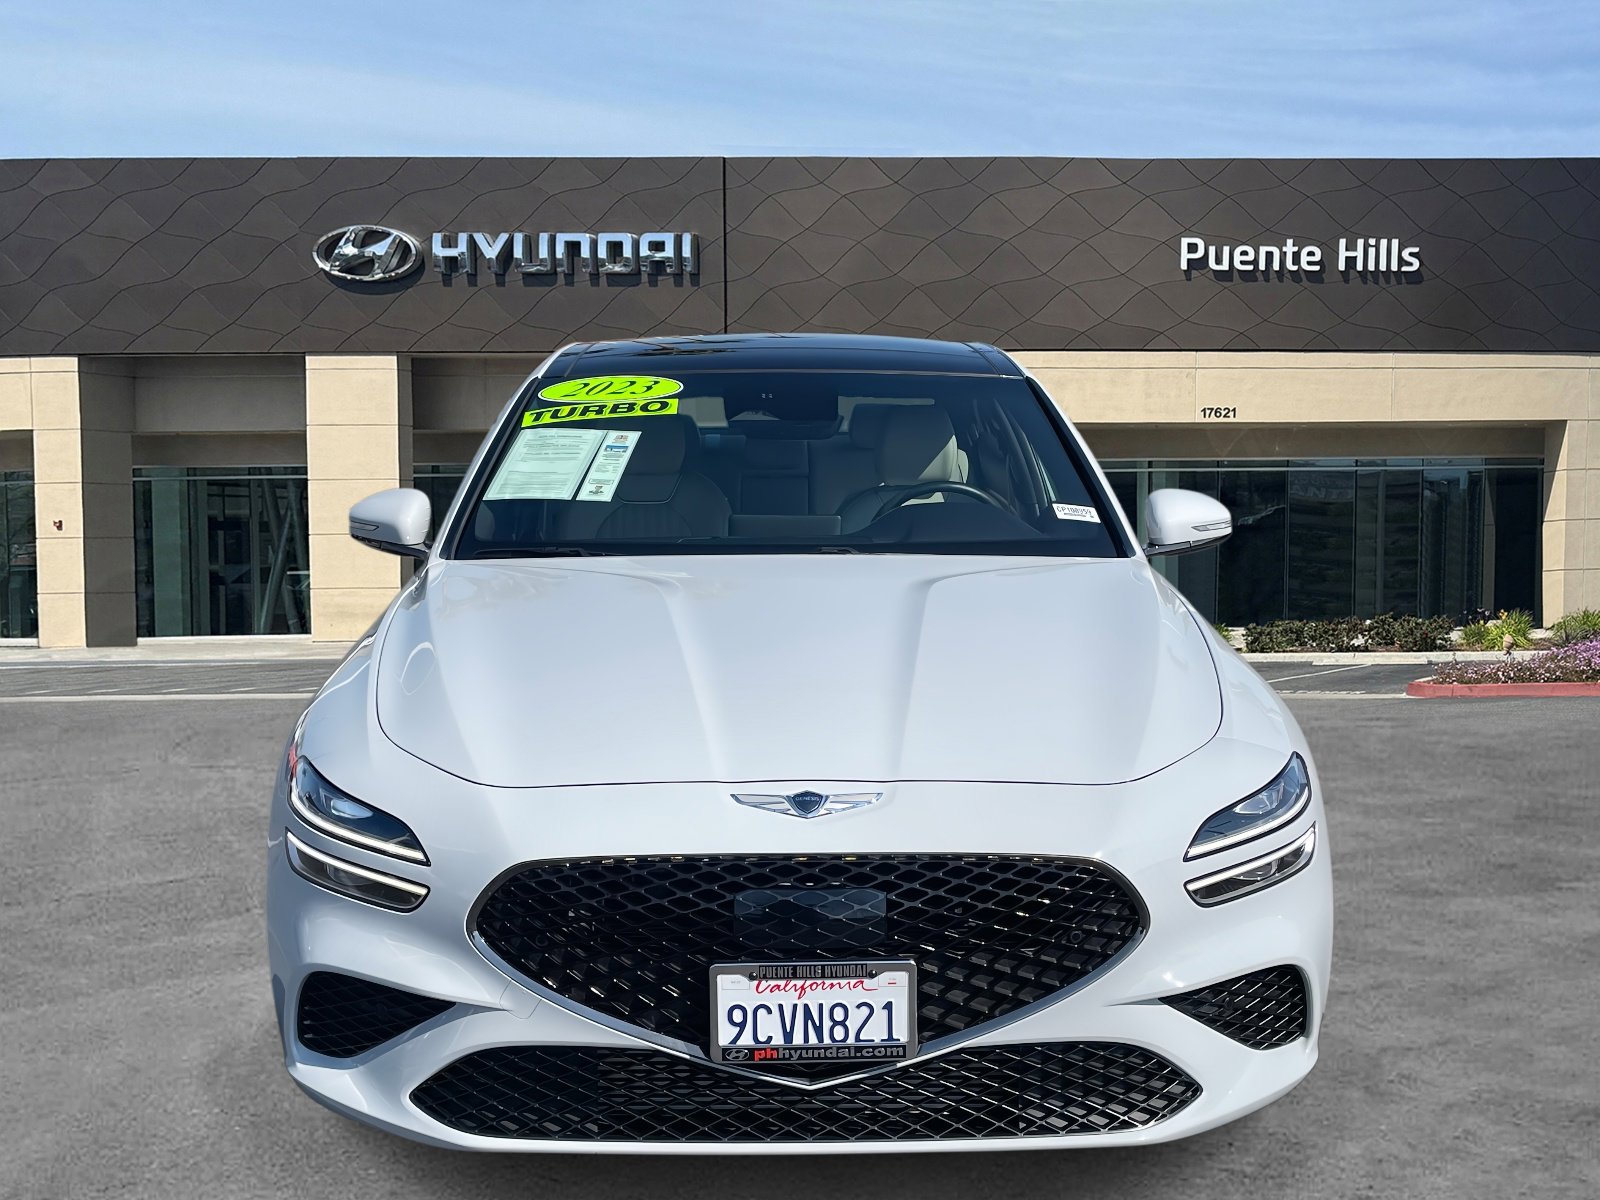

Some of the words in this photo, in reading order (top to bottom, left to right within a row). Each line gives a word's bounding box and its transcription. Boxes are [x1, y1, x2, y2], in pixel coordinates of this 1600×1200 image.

[431, 231, 700, 275] HYUNDAI
[1179, 236, 1322, 272] Puente
[1337, 238, 1421, 273] Hills
[560, 380, 661, 398] 2023
[529, 400, 670, 423] TURBO
[1200, 406, 1237, 419] 17621
[759, 965, 794, 979] PUENTE
[796, 965, 822, 978] HILLS
[824, 964, 868, 978] HYUNDAI
[755, 979, 879, 1000] California
[727, 1001, 901, 1045] 9CVN821
[754, 1047, 904, 1062] phhyundai.com
